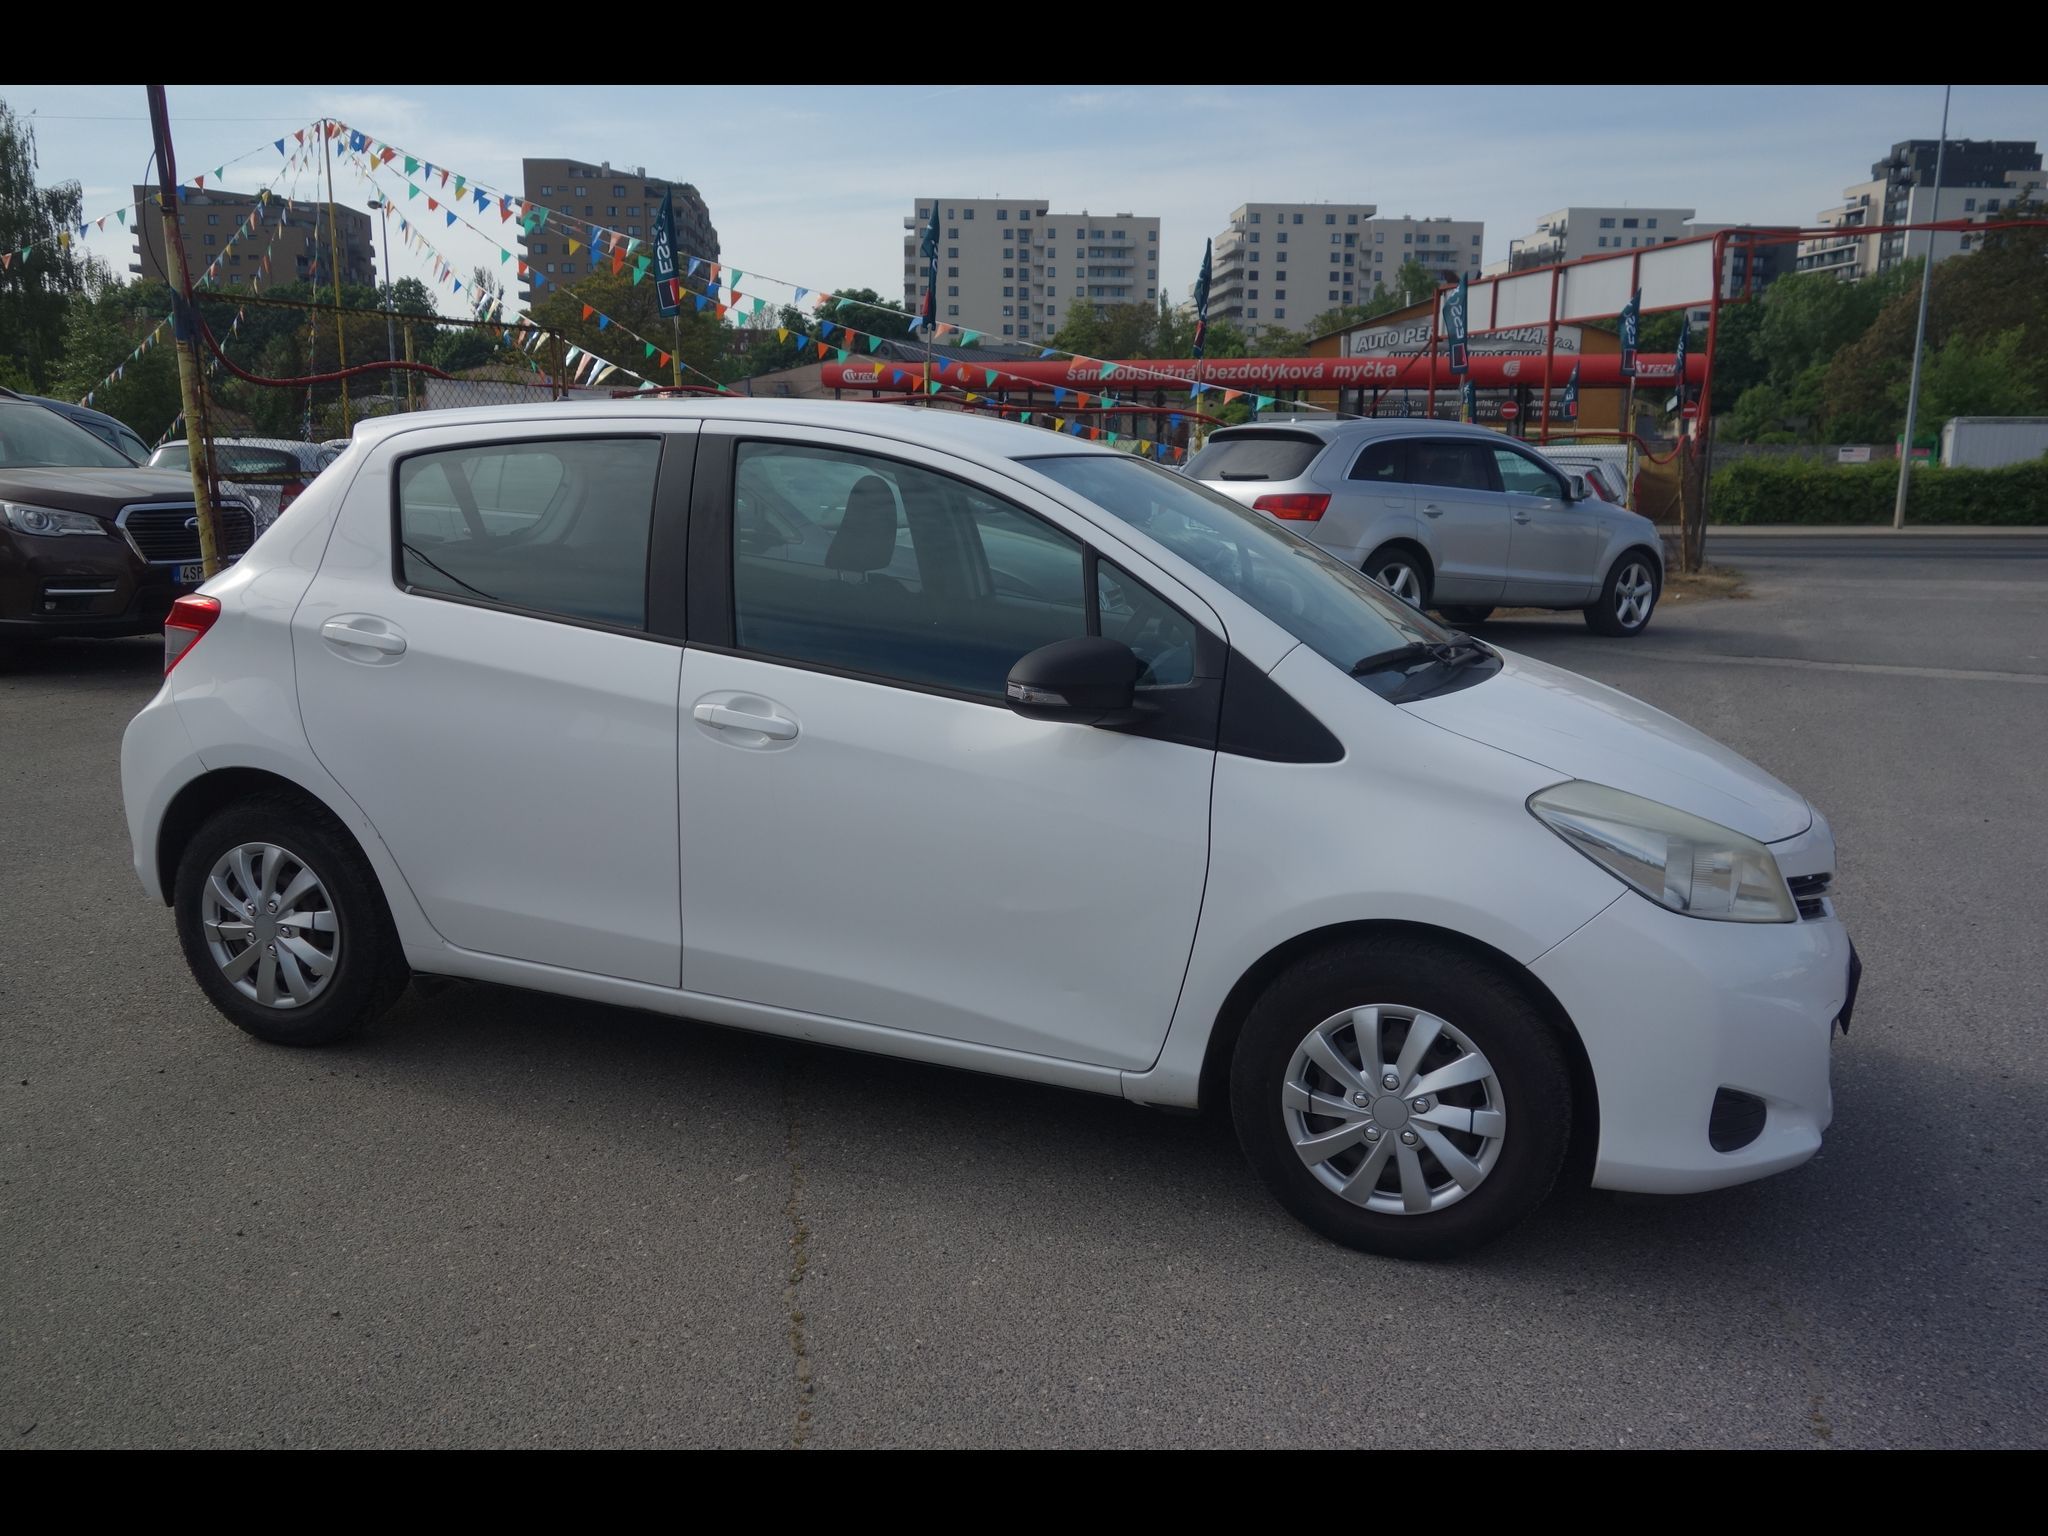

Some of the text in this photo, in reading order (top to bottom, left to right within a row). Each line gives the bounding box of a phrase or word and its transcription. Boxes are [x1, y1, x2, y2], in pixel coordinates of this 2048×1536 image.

[1356, 331, 1400, 353] AUTO
[1206, 362, 1324, 382] bezdotyková
[1333, 361, 1397, 382] myčka
